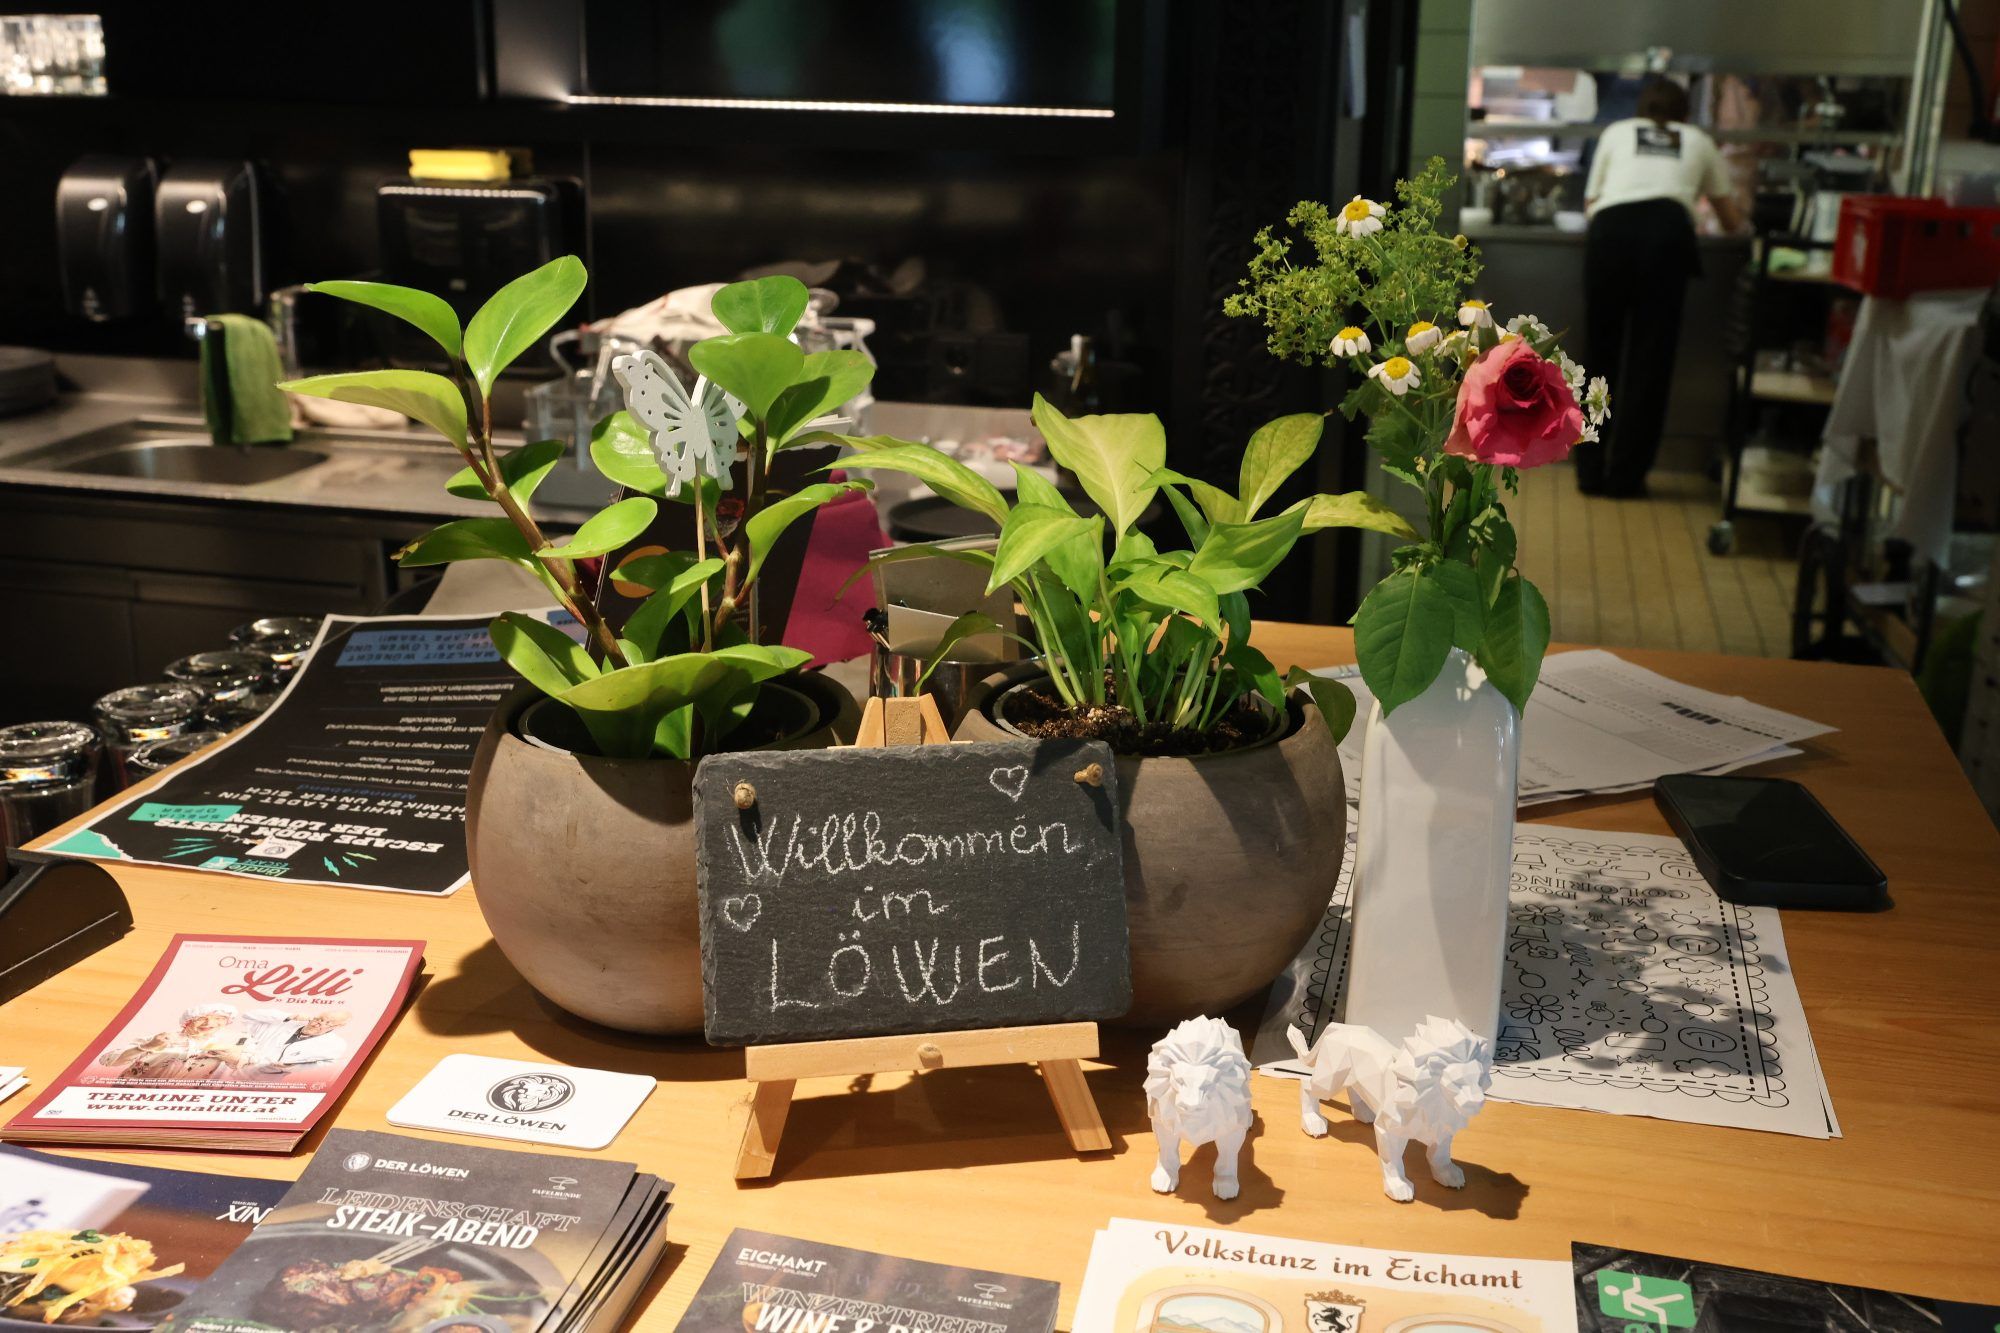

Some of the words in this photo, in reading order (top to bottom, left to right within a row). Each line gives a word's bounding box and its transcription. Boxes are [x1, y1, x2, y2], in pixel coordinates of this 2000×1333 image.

[218, 792, 252, 801] EIN
[244, 787, 293, 797] SICH
[300, 792, 369, 804] UNTER
[336, 804, 403, 816] WHITE
[377, 800, 466, 814] HEMIKER
[224, 813, 327, 832] LÖWEN
[414, 811, 466, 822] LTER
[154, 818, 250, 834] MEETS
[251, 826, 331, 842] ROOM
[329, 824, 388, 837] DER
[333, 834, 445, 853] ESCAPE
[852, 885, 950, 922] im
[219, 956, 269, 969] Oma
[770, 920, 1080, 1013] LÖWEN
[220, 964, 364, 1002] Lilli
[87, 1092, 204, 1104] TERMINE
[210, 1095, 297, 1106] UNTER
[87, 1103, 278, 1114] www.omalilli.at
[448, 1109, 489, 1121] DER
[491, 1115, 566, 1131] LÖWEN
[374, 1158, 408, 1171] DER
[409, 1163, 470, 1178] LÖWEN
[317, 1187, 582, 1232] LEIDENSCHAFT
[326, 1205, 539, 1249] STEAK-ABEND
[738, 1247, 828, 1273] EICHAMT
[1155, 1230, 1318, 1272] Volkstanz
[1331, 1257, 1373, 1278] im
[1386, 1255, 1523, 1289] Eichamt
[957, 1296, 1013, 1310] TAFELRUNDE
[754, 1303, 846, 1333] WINE
